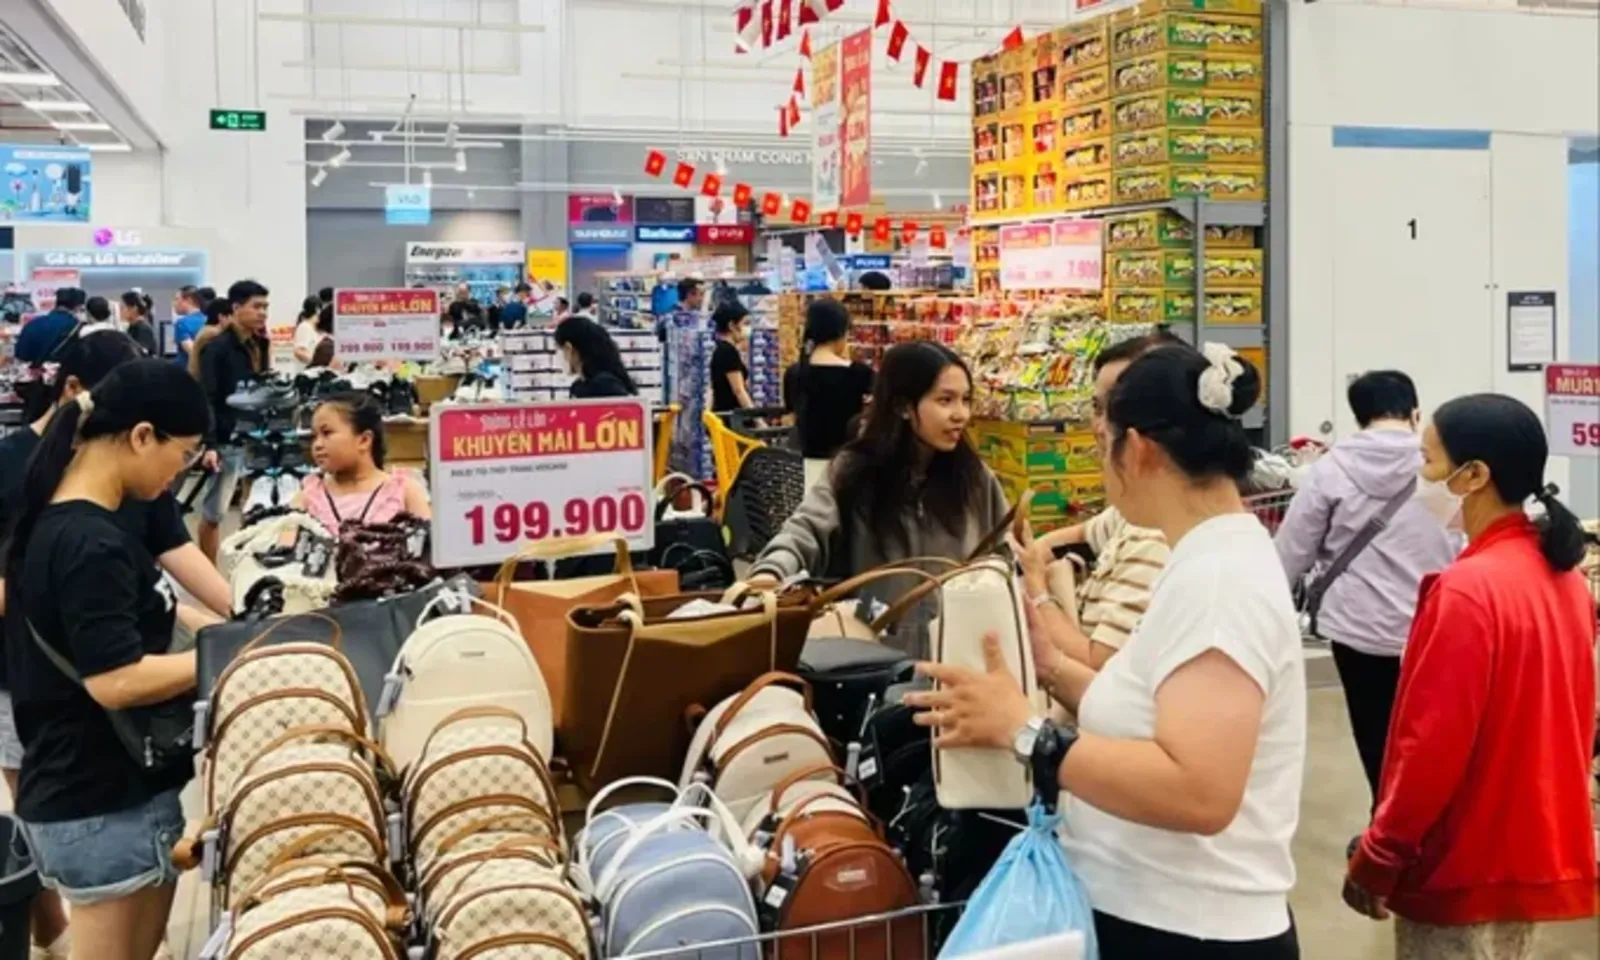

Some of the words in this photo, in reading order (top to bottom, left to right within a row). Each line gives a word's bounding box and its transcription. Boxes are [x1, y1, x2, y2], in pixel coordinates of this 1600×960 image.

[115, 230, 142, 246] LG
[1407, 218, 1417, 240] 1
[410, 245, 463, 260] Energizer
[453, 430, 532, 457] KHUYẾN
[538, 428, 573, 453] MÃI
[577, 411, 639, 450] LỚN
[464, 493, 646, 546] 199.900
